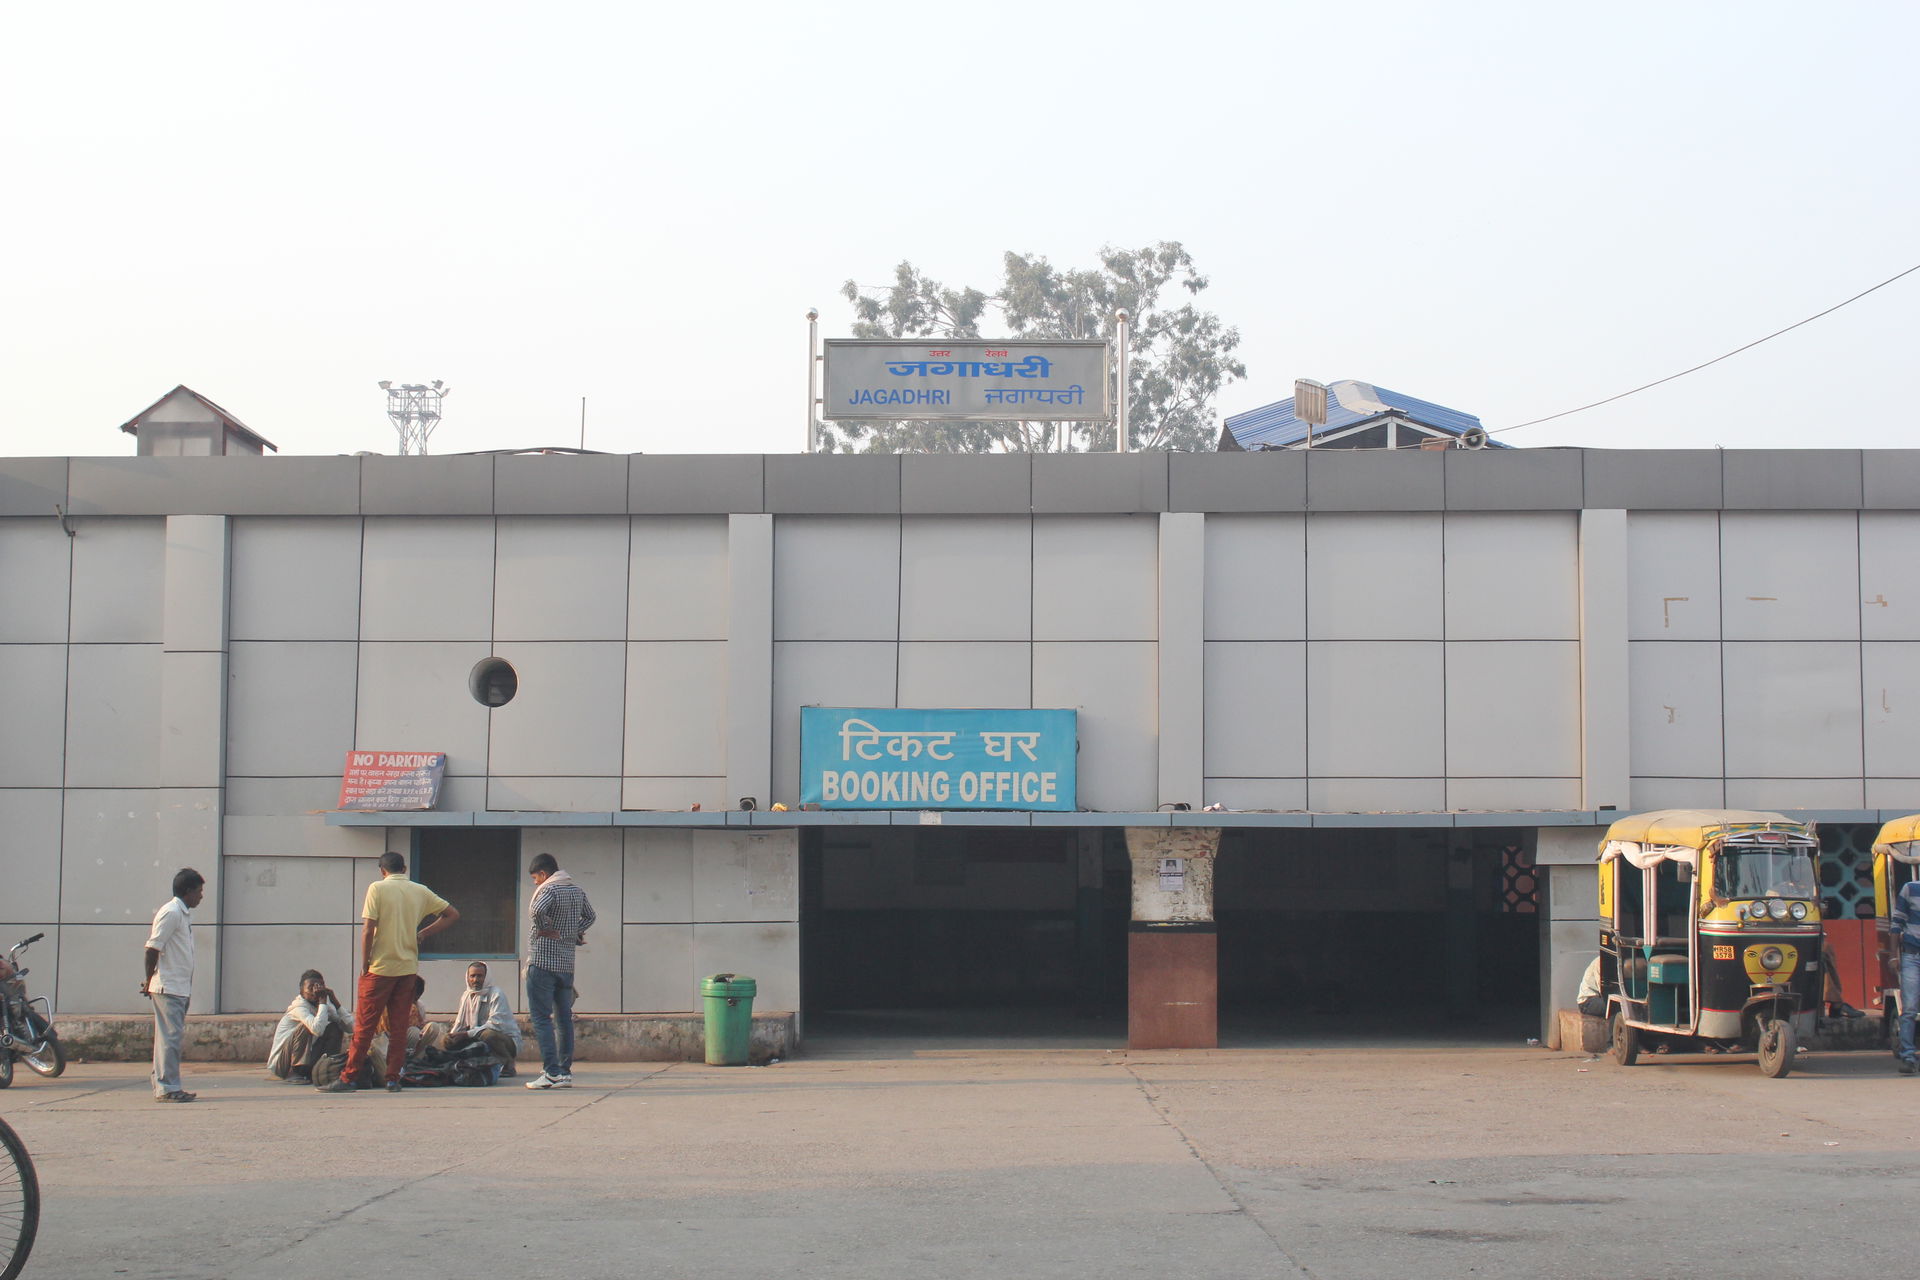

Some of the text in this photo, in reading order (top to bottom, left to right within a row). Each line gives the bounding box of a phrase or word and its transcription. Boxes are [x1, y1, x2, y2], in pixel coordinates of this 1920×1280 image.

[885, 355, 1053, 378] जगाधरी
[849, 389, 950, 404] JAGADHRI
[984, 384, 1086, 405] ਜਗਾਧਰੀ
[838, 718, 1041, 762] टिकट घर
[353, 754, 438, 767] NO PARKING
[822, 770, 1057, 802] BOOKING OFFICE
